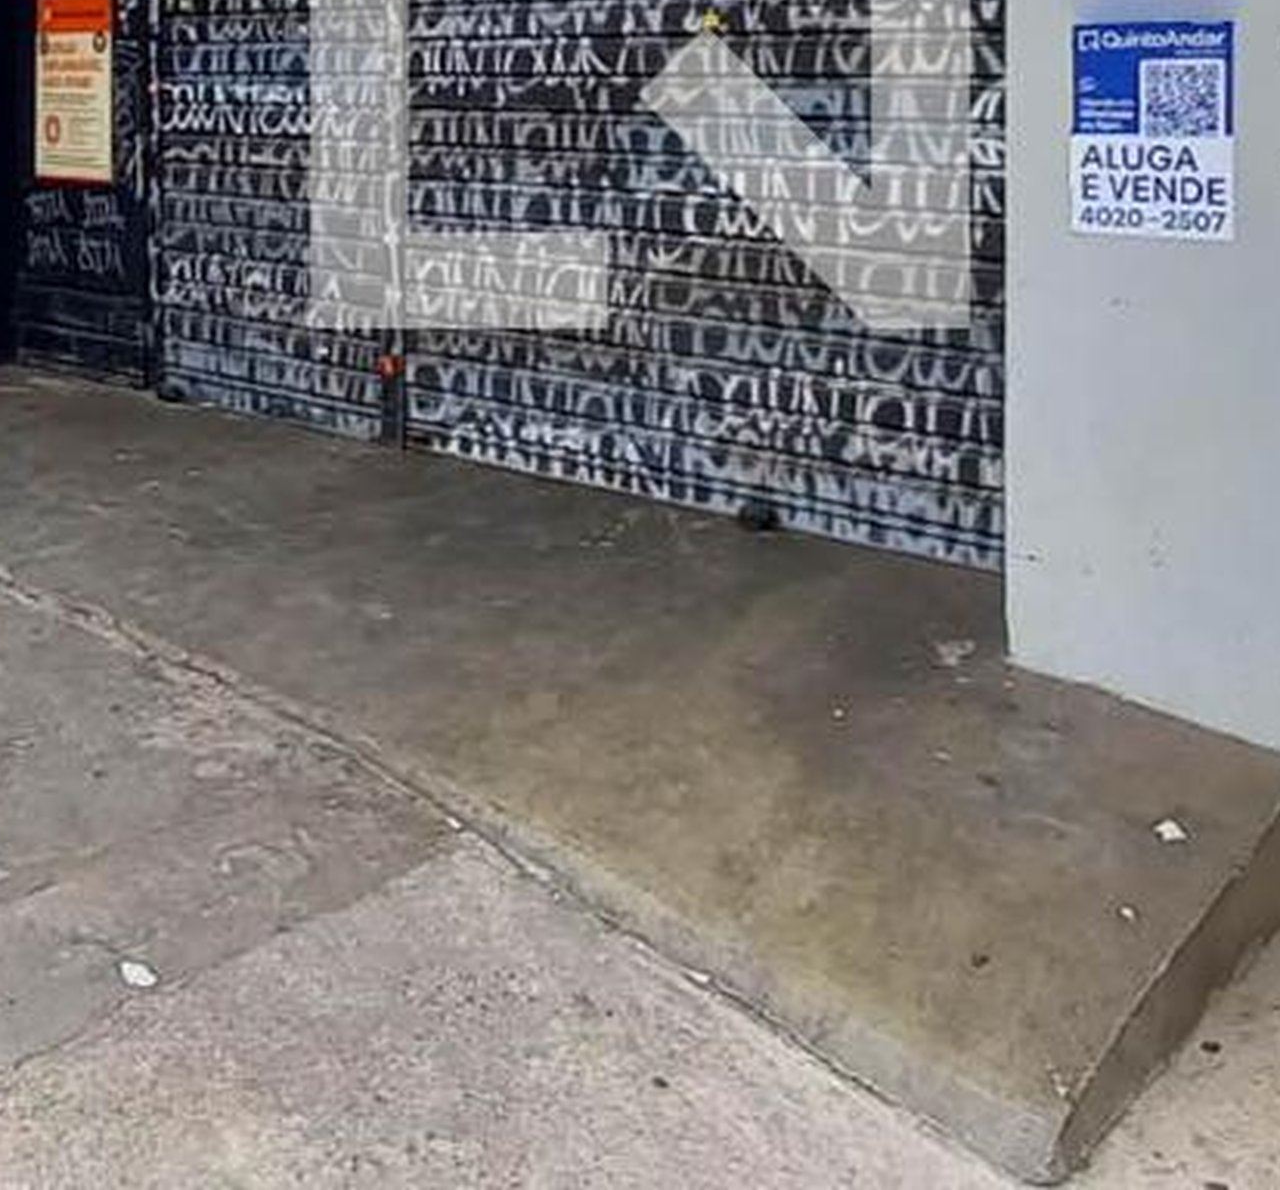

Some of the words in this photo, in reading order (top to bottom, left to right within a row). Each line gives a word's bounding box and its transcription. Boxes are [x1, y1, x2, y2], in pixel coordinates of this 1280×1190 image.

[1103, 29, 1226, 49] QuintoAndar
[1081, 145, 1199, 172] ALUGA
[1081, 173, 1099, 201] E
[1109, 174, 1227, 207] VENDE
[1080, 206, 1226, 233] 4020-2507
